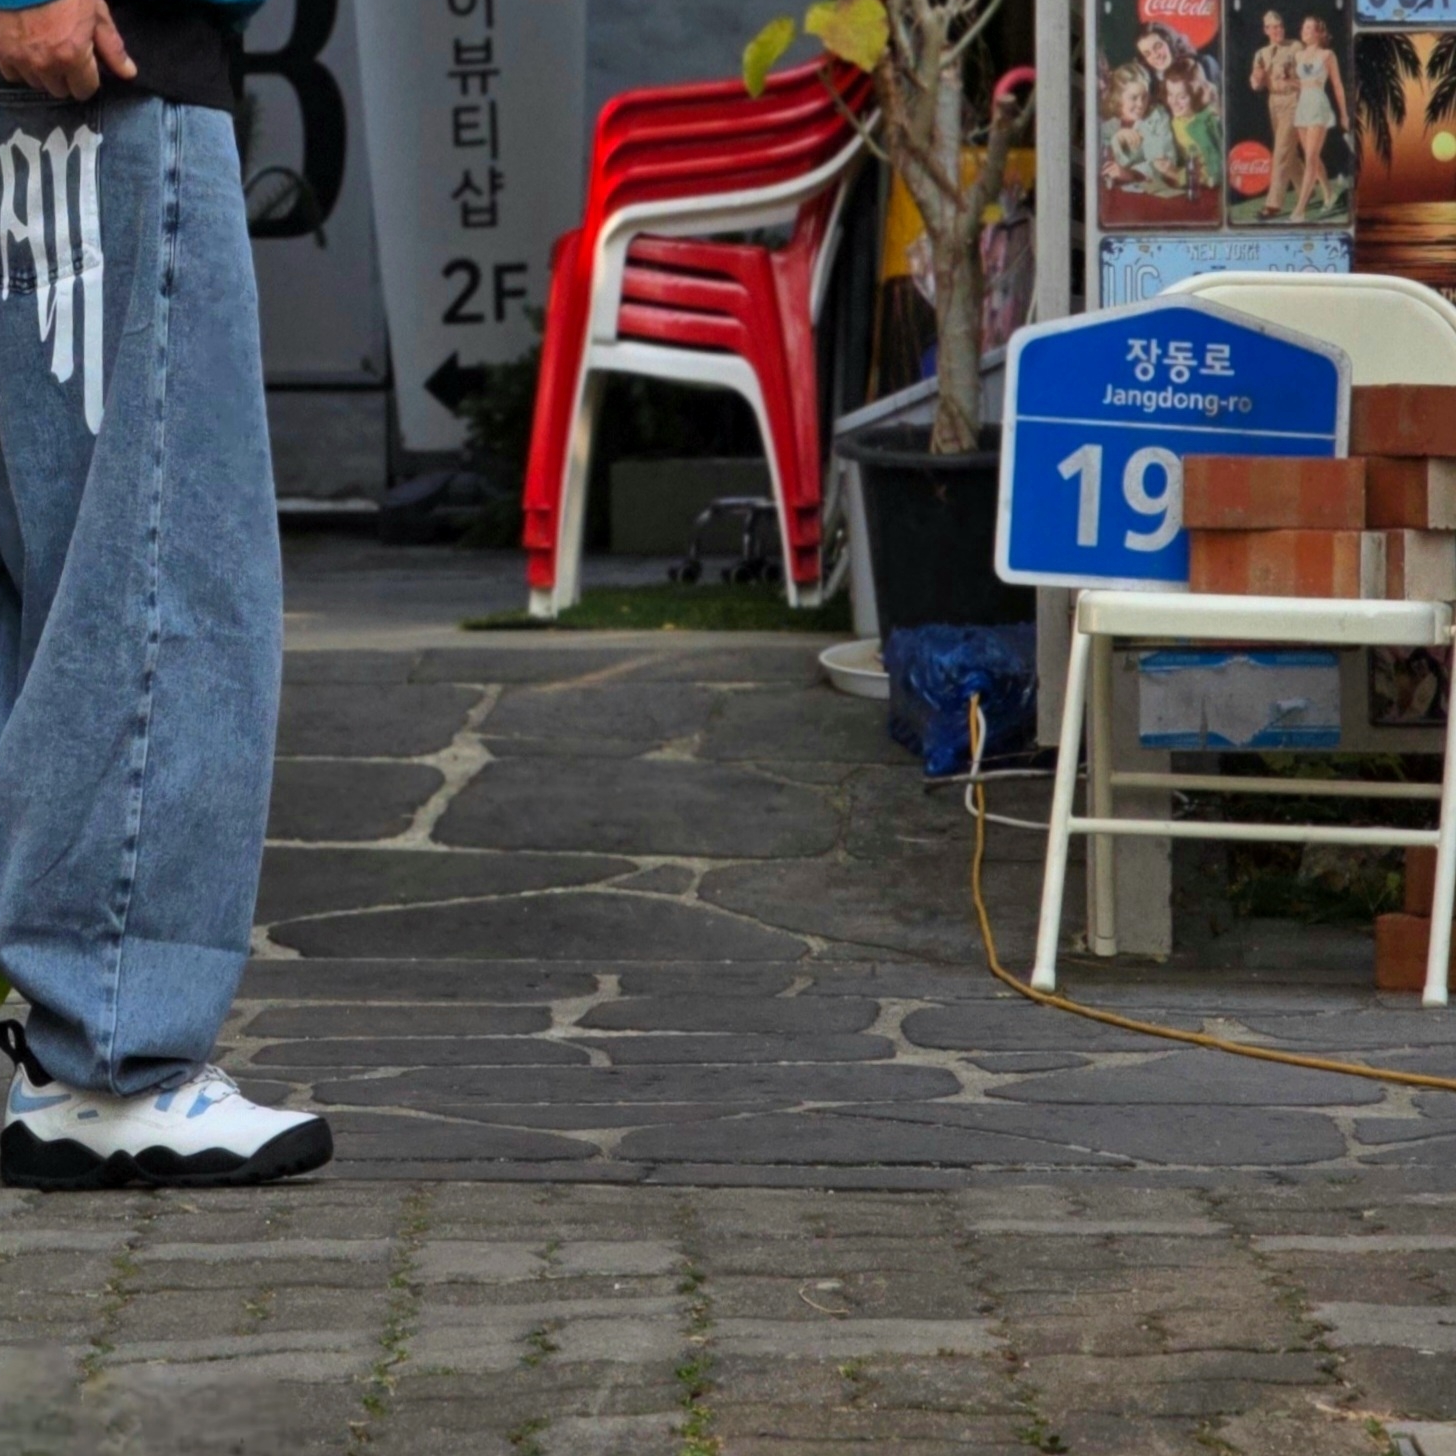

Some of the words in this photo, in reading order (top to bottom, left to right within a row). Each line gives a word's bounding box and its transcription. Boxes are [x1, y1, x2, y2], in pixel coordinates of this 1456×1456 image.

[1189, 243, 1218, 261] NEW
[1226, 243, 1261, 261] YORK
[441, 258, 529, 326] 2F
[1126, 338, 1235, 384] 장동로
[1102, 383, 1253, 417] Jangdong-ro
